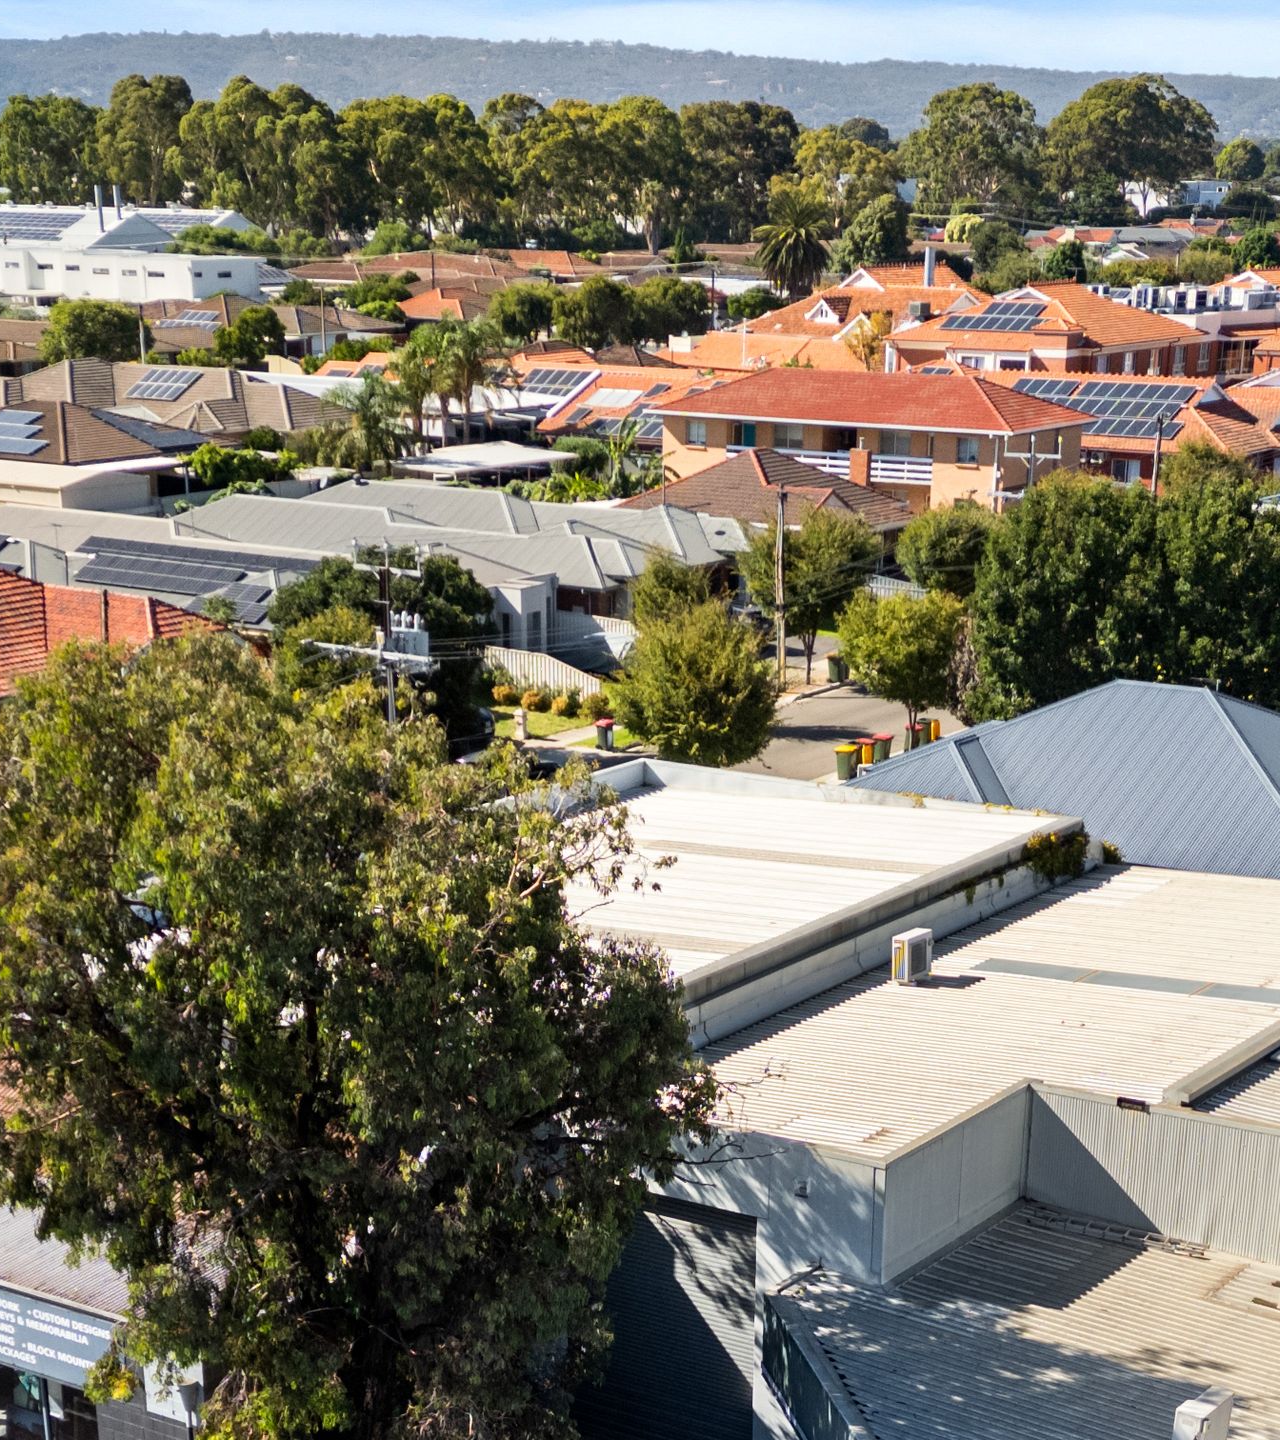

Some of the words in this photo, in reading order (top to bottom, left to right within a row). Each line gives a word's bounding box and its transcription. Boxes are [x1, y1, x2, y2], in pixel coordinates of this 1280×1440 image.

[17, 1315, 25, 1326] &
[26, 1318, 90, 1346] MEMORABILIA
[33, 1309, 72, 1328] CUSTOM
[72, 1319, 112, 1340] DESIGNS
[27, 1342, 57, 1359] BLOCK
